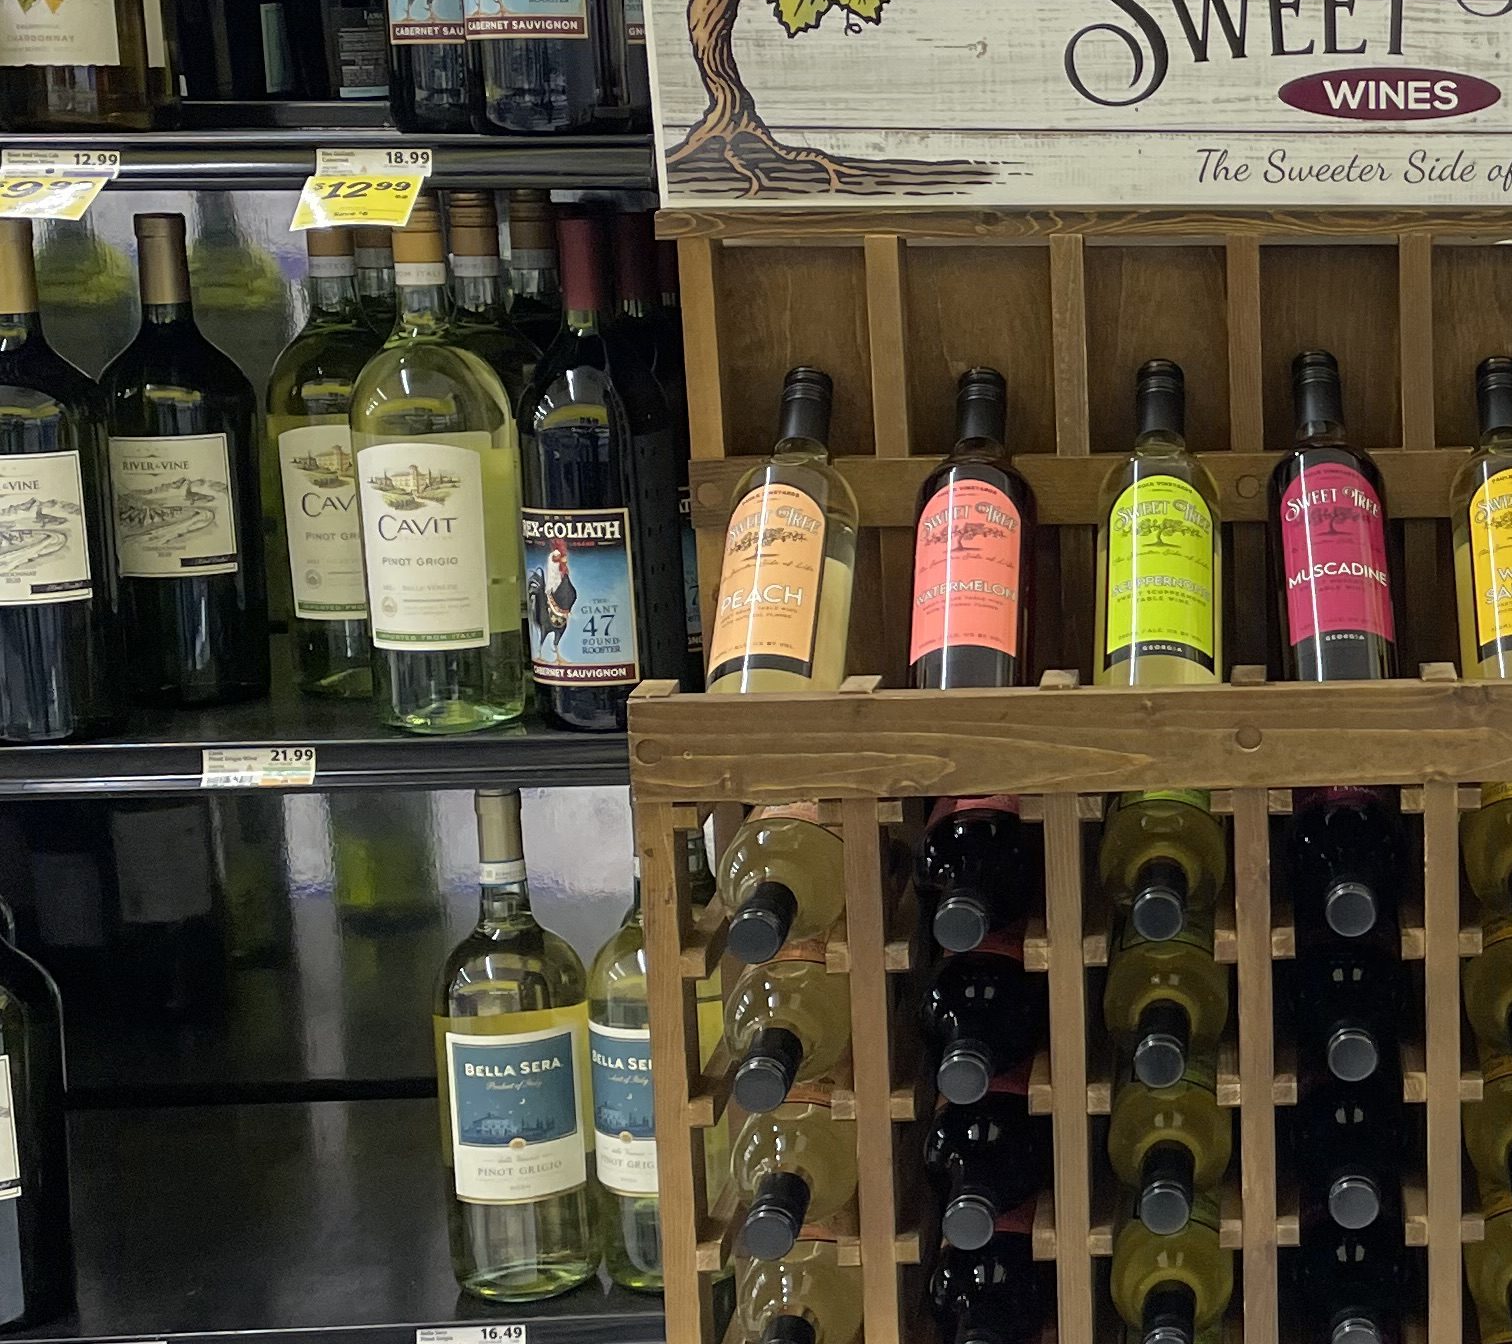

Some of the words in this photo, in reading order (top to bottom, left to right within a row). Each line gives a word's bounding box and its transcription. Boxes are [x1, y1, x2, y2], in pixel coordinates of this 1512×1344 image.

[395, 26, 440, 37] CABERNET
[468, 20, 509, 32] CABERNET
[512, 20, 578, 31] SAUVIGNON
[1322, 80, 1459, 110] WINES
[74, 153, 118, 166] 12.99
[385, 151, 430, 165] 18.99
[1196, 148, 1252, 184] The
[1264, 148, 1392, 183] Sweeter
[1403, 149, 1477, 184] Side
[122, 461, 154, 471] RIVER
[161, 461, 190, 471] VINE
[9, 480, 40, 491] VINE
[1286, 488, 1338, 522] SWEET
[1341, 486, 1380, 518] TREE
[378, 515, 458, 541] CAVIT
[522, 520, 621, 539] REX-GOLIATH
[305, 532, 336, 541] PINOT
[382, 558, 411, 567] PINOT
[416, 557, 458, 567] GRIGIO
[1288, 562, 1388, 590] MUSCADINE
[916, 579, 1017, 606] WATERMELON
[720, 584, 803, 617] PEACH
[580, 605, 619, 615] GIANT
[582, 615, 615, 637] 47
[582, 646, 622, 654] ROOSTER
[567, 667, 627, 678] SAUVIGNON
[271, 749, 314, 762] 21.99
[592, 1049, 624, 1070] BELLA
[464, 1063, 517, 1078] BELLA
[520, 1057, 562, 1074] SERA
[478, 1166, 513, 1177] PINOT
[519, 1160, 563, 1175] GRIGIO
[481, 1327, 522, 1340] 16.49
